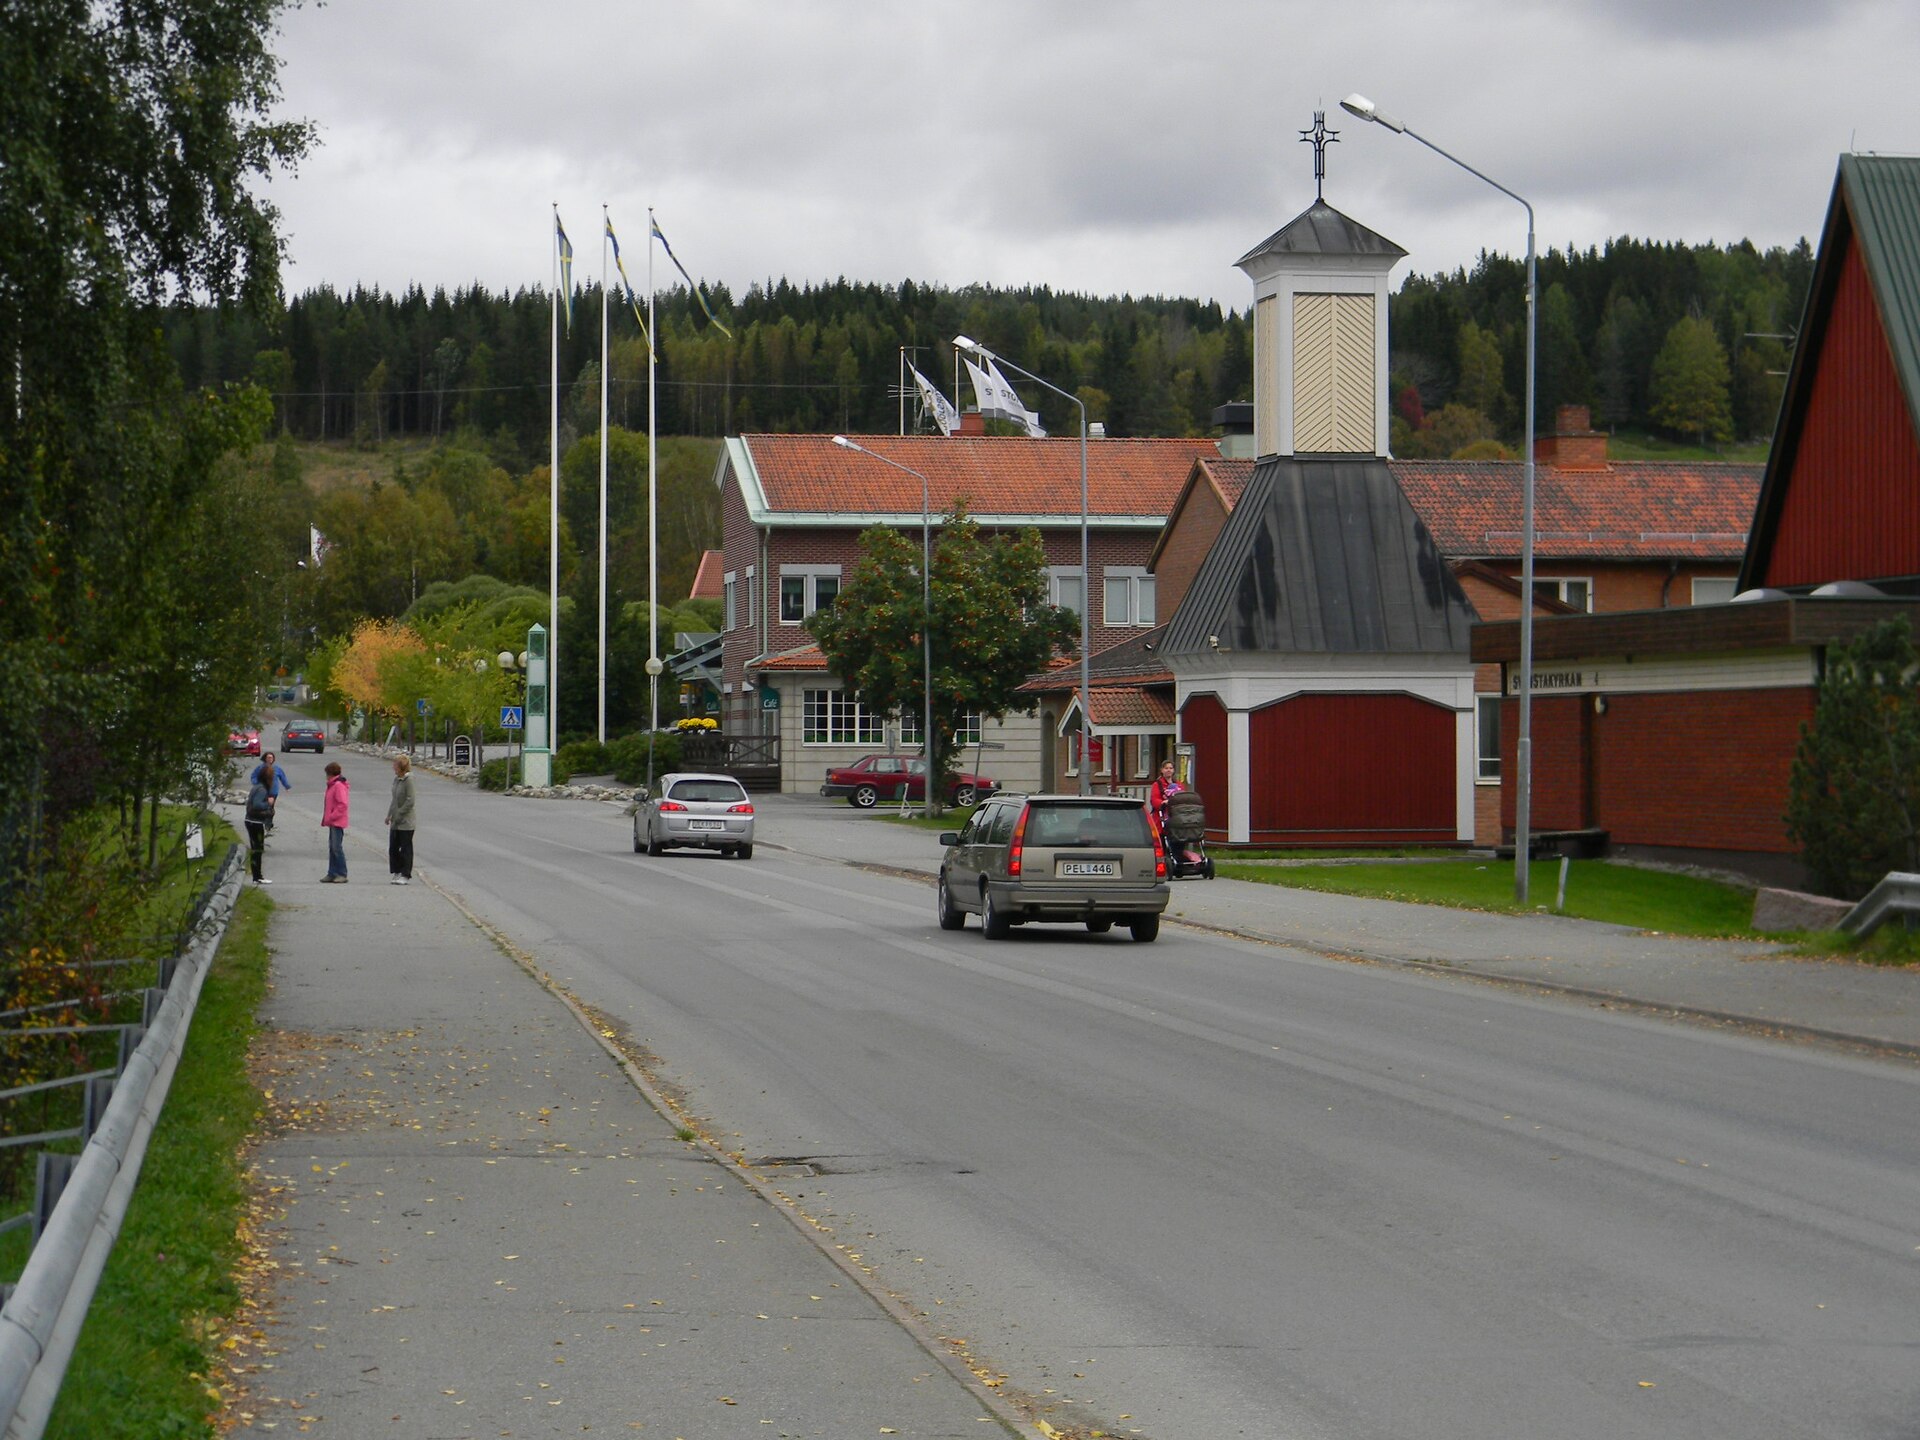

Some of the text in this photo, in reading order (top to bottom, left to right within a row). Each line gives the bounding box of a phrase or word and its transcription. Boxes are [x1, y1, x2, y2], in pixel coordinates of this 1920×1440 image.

[1512, 672, 1582, 690] SVSTAKYRKAN
[1065, 864, 1112, 873] PEL 446
